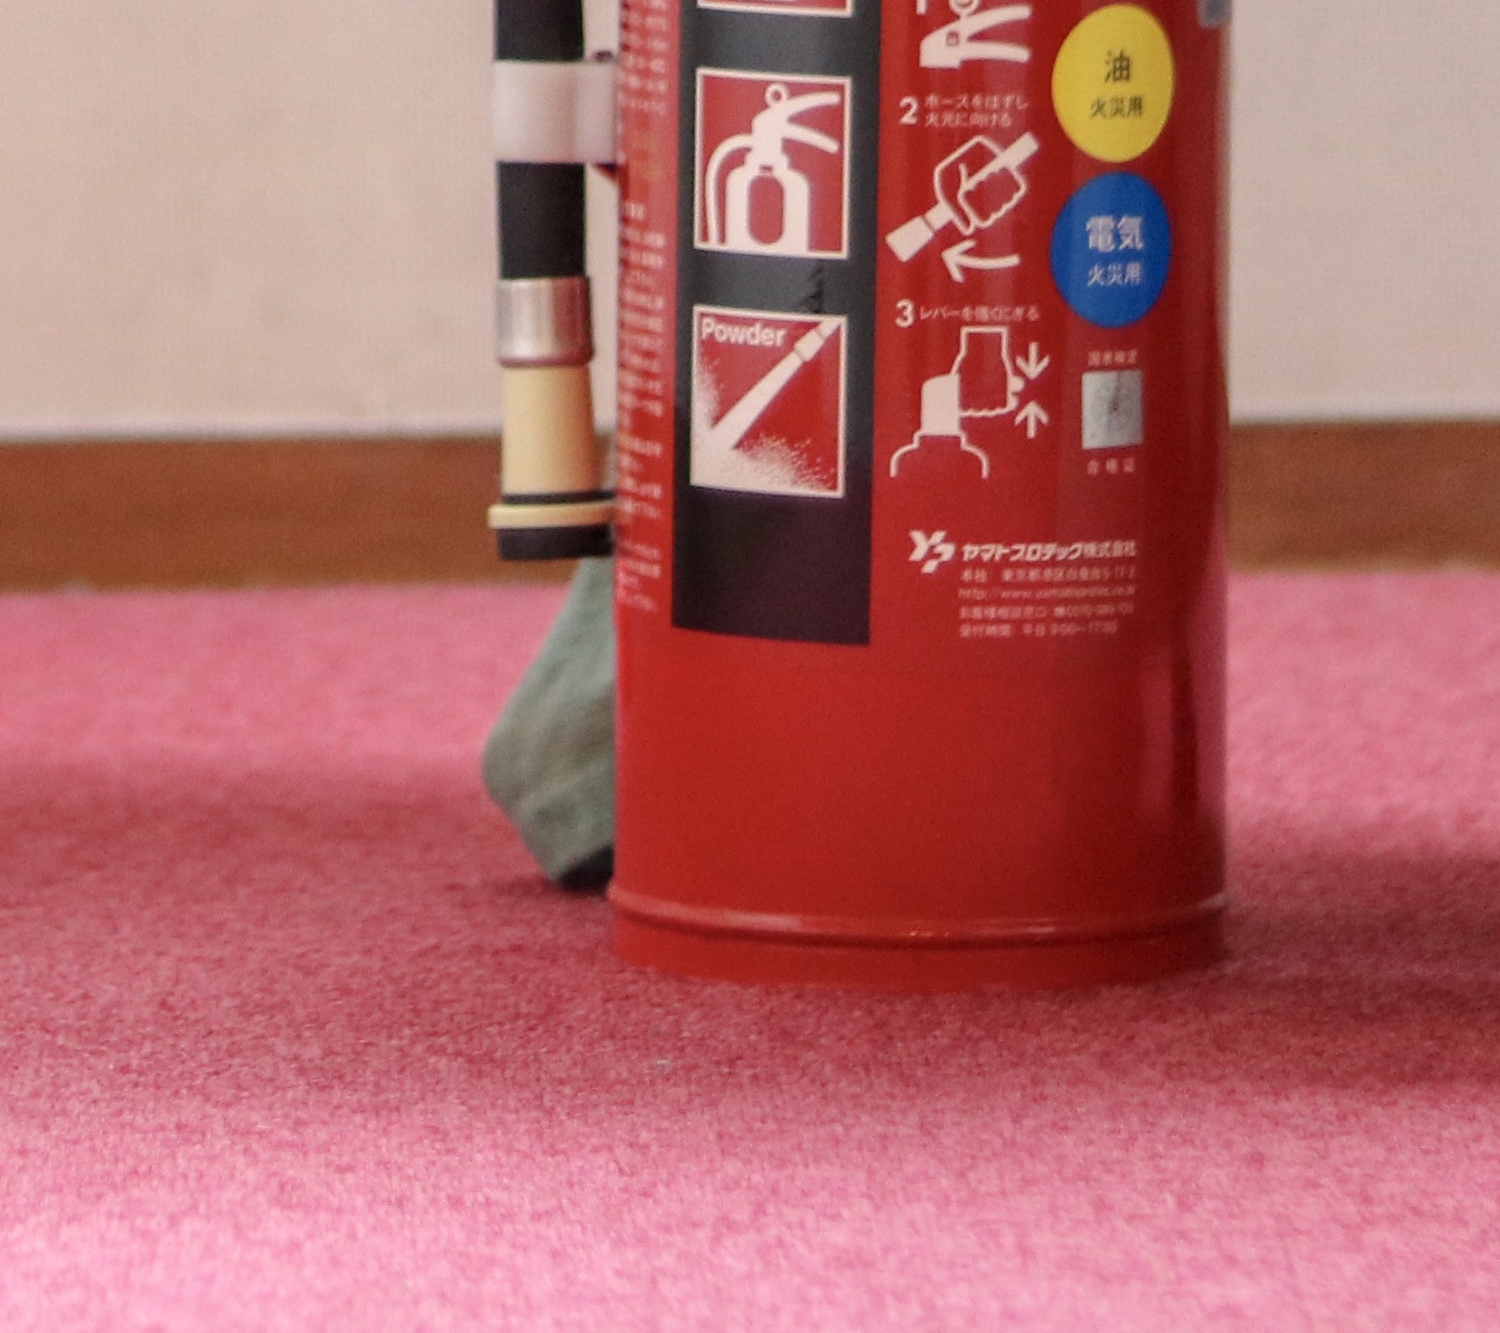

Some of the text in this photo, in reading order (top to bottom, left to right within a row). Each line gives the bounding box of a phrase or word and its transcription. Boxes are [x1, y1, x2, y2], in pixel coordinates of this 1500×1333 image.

[1105, 50, 1131, 83] 油
[899, 96, 919, 125] 2
[1090, 95, 1144, 118] 火災用
[1085, 215, 1144, 252] 電気
[1087, 262, 1142, 288] 火災用
[895, 298, 915, 328] 3
[702, 318, 787, 348] Powder
